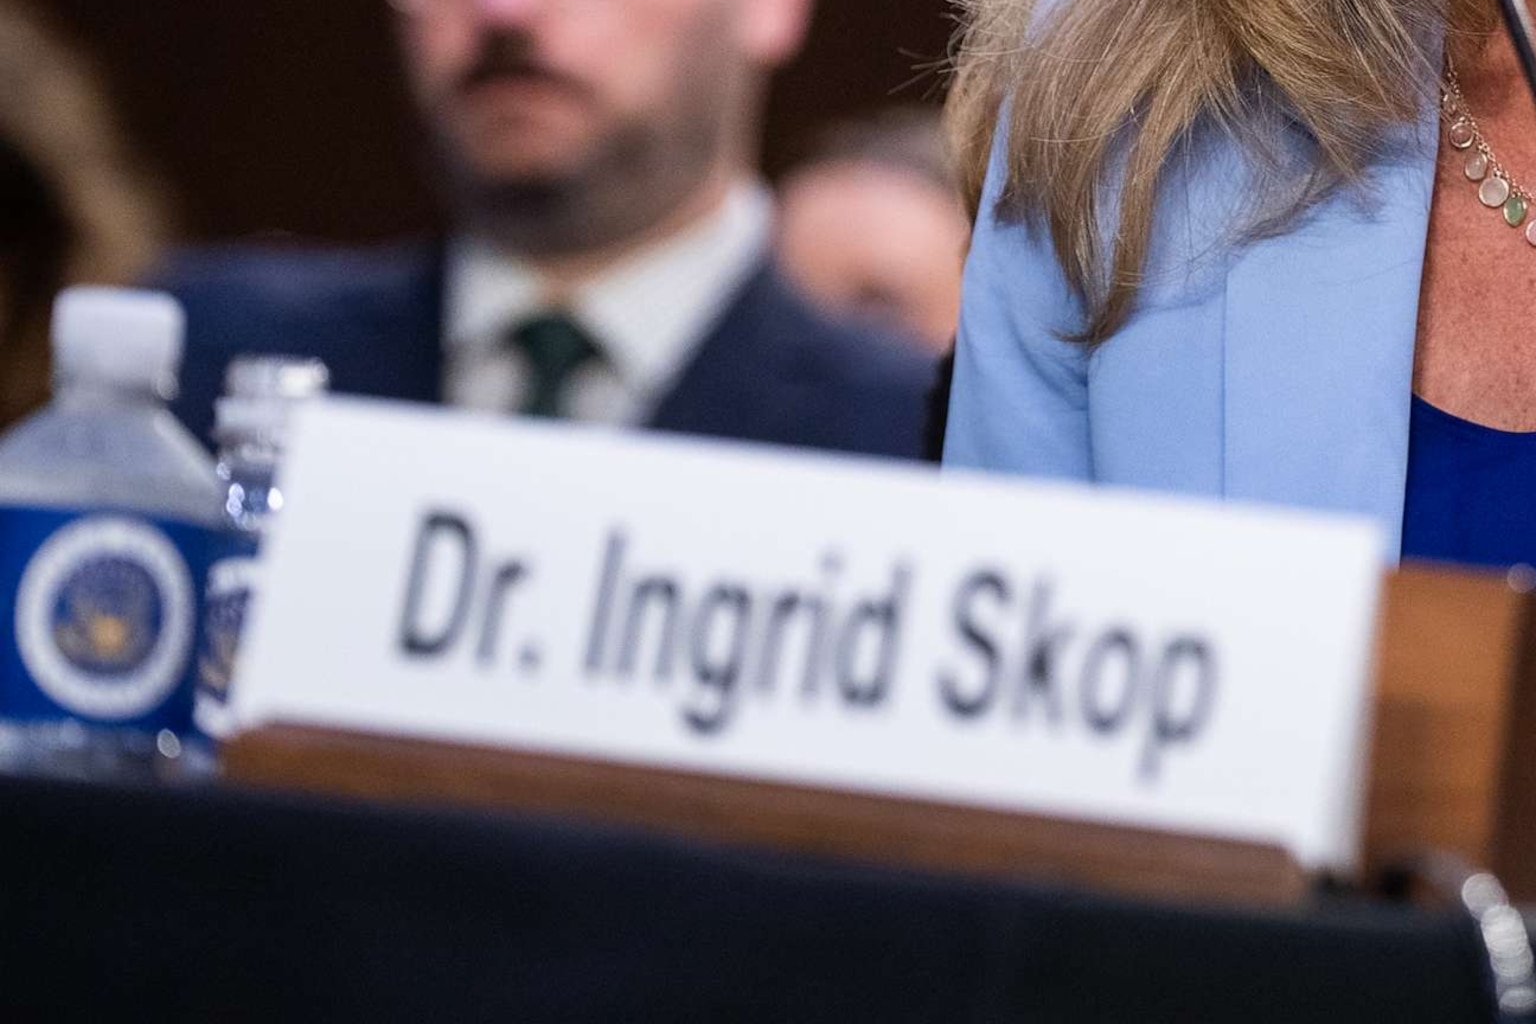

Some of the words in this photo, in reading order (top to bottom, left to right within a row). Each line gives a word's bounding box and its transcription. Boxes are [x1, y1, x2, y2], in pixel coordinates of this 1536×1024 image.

[398, 508, 546, 672] Dr.
[584, 525, 906, 736] Ingrid
[934, 568, 1218, 782] Skop
